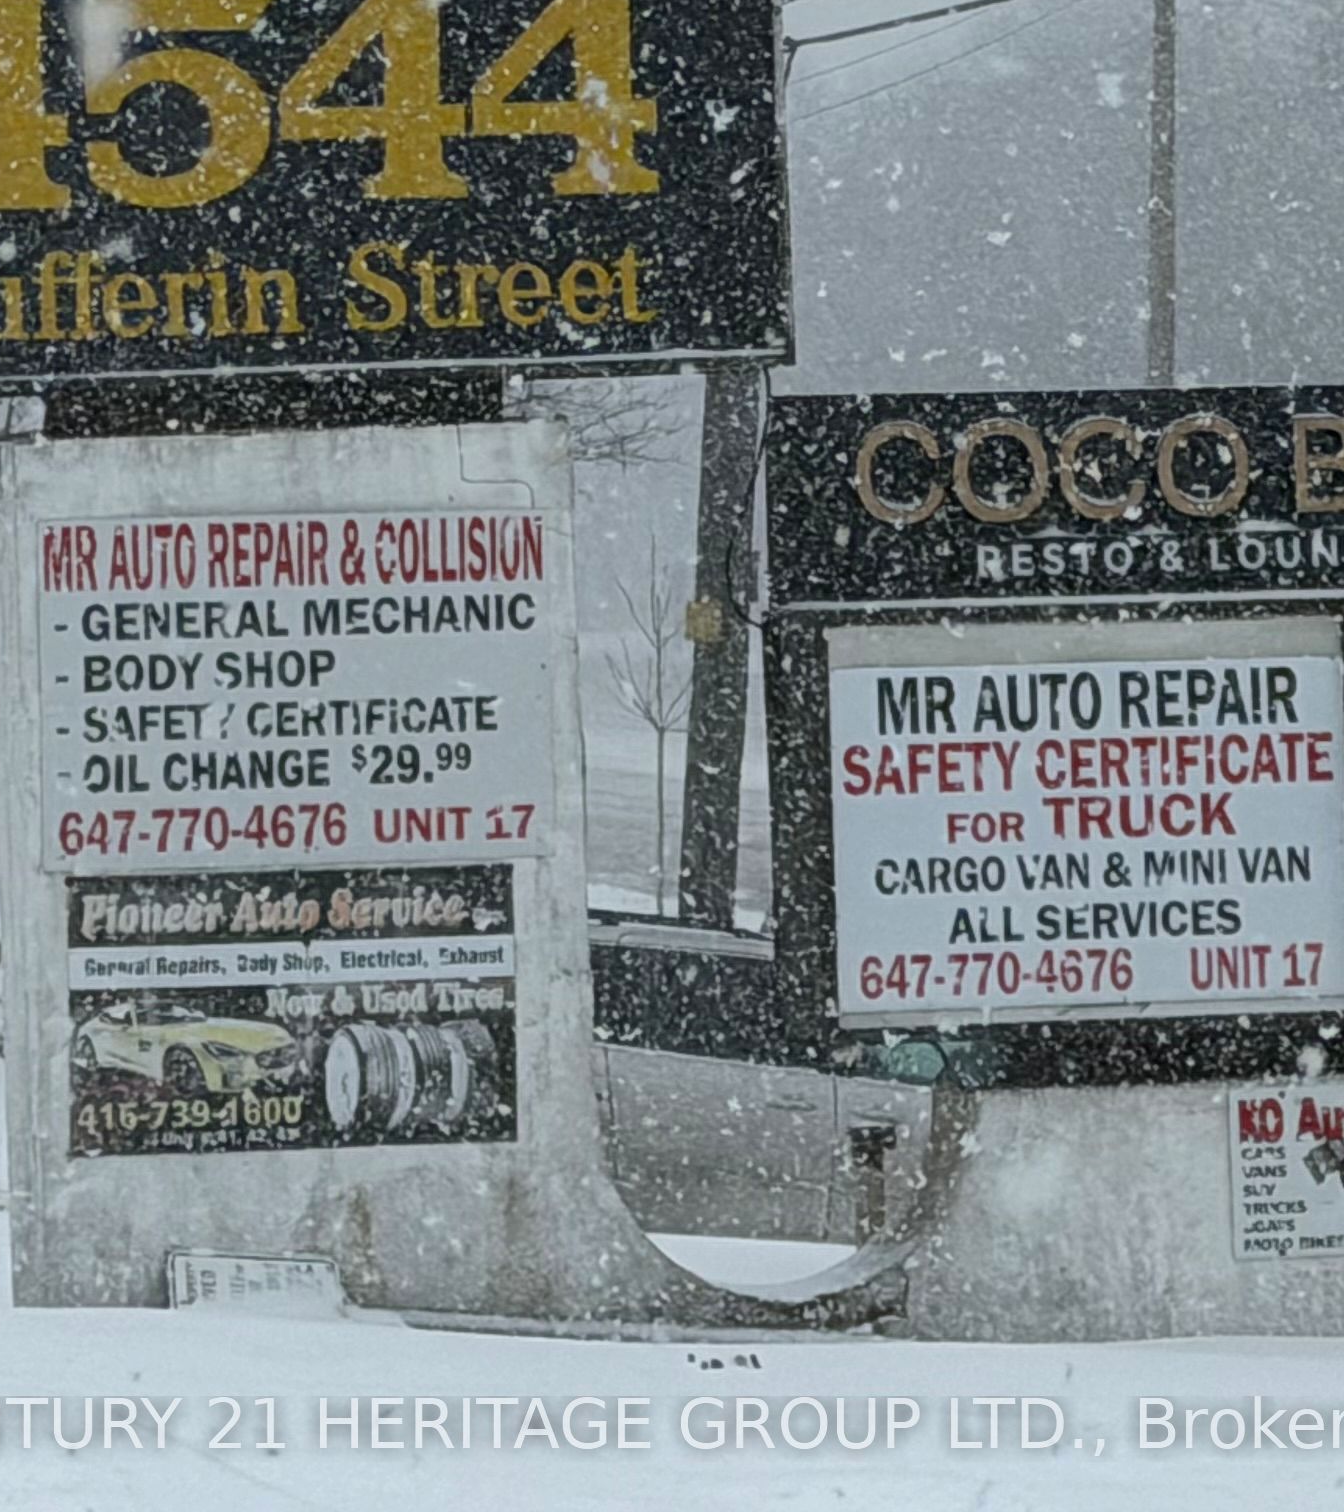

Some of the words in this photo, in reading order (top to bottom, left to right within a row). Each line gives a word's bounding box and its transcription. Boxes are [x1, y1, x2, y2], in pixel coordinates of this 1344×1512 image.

[346, 241, 656, 332] Street
[856, 413, 1252, 524] COCO
[44, 525, 97, 592] MR
[109, 523, 197, 591] AUTO
[208, 520, 330, 587] REPAIR
[340, 518, 366, 585] &
[375, 515, 544, 584] COLLISION
[976, 541, 1136, 579] RESTO
[1159, 541, 1189, 574] &
[81, 601, 289, 641] GENERAL
[303, 593, 536, 636] MECHANIC
[84, 654, 202, 693] BODY
[215, 650, 335, 688] SHOP
[247, 696, 499, 738] CERTIFICATE
[877, 676, 956, 735] MR
[973, 671, 1102, 733] AUTO
[1120, 666, 1299, 729] REPAIR
[83, 755, 150, 793] OIL
[163, 749, 330, 791] CHANGE
[351, 743, 472, 785] $29.99
[843, 741, 1020, 795] SAFETY
[1035, 732, 1333, 789] CERTIFICATE
[58, 803, 347, 856] 647-770-4676
[373, 806, 471, 843] UNIT
[485, 804, 535, 840] 17
[947, 811, 1024, 844] FOR
[1042, 792, 1236, 840] TRUCK
[875, 856, 1005, 895] CARGO
[1016, 852, 1089, 891] VAN
[1103, 852, 1131, 887] &
[1144, 849, 1226, 886] MINI
[1238, 845, 1311, 883] VAN
[81, 892, 223, 941] Pioneer
[229, 892, 320, 934] Auto
[328, 887, 469, 930] Service
[949, 906, 1024, 944] ALL
[1036, 900, 1242, 939] SERVICES
[84, 956, 150, 977] General
[157, 956, 227, 977] Repairs,
[237, 954, 277, 976] Body
[283, 952, 330, 973] Shop,
[340, 949, 429, 969] Electrical,
[439, 946, 504, 966] Exhaust
[860, 949, 1133, 999] 647-770-4676
[1190, 945, 1271, 990] UNIT
[1283, 942, 1324, 986] 17
[265, 988, 325, 1016] New
[331, 986, 355, 1015] &
[361, 983, 427, 1013] Used
[77, 1093, 305, 1132] 416-739-1600
[1241, 1147, 1286, 1161] CARS
[1241, 1165, 1287, 1179] VANS
[1242, 1200, 1308, 1216] TRUCKS
